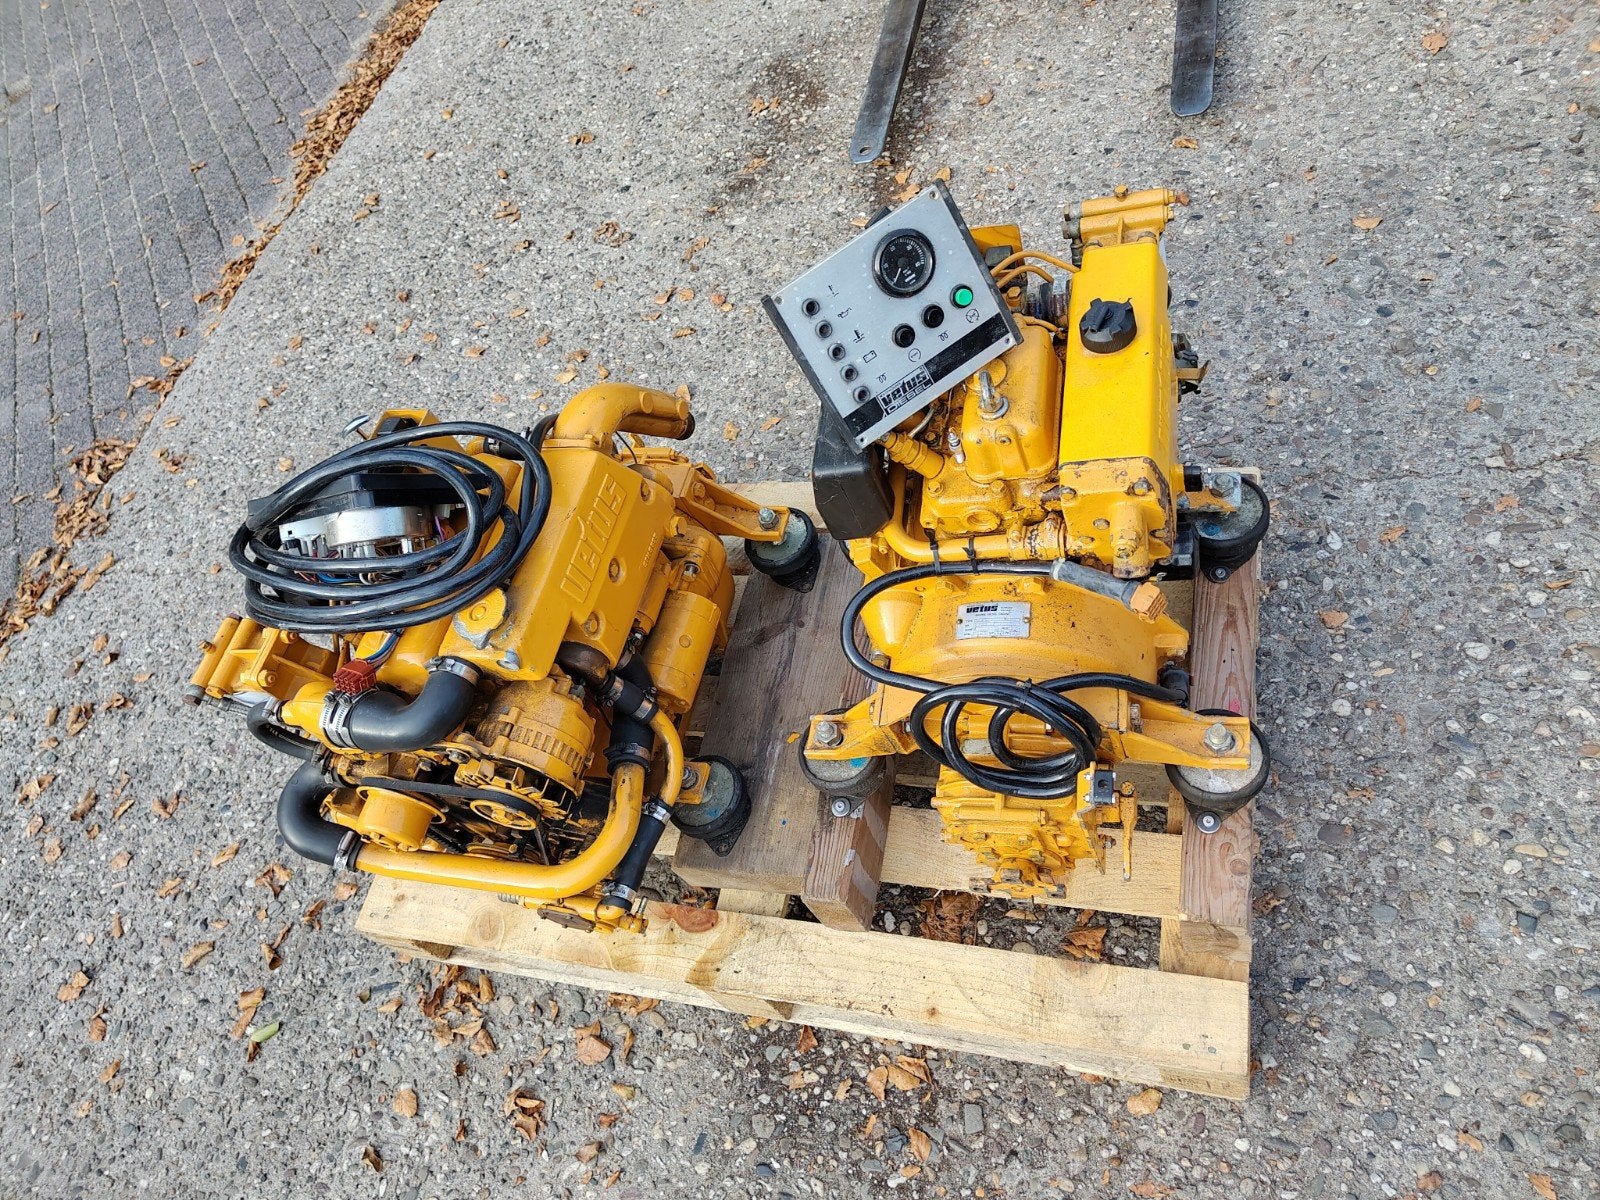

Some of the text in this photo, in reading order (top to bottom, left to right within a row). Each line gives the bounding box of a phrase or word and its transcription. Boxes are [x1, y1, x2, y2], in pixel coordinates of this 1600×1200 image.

[881, 369, 929, 407] vetus
[886, 381, 933, 415] DIESEL
[966, 605, 999, 613] vetus
